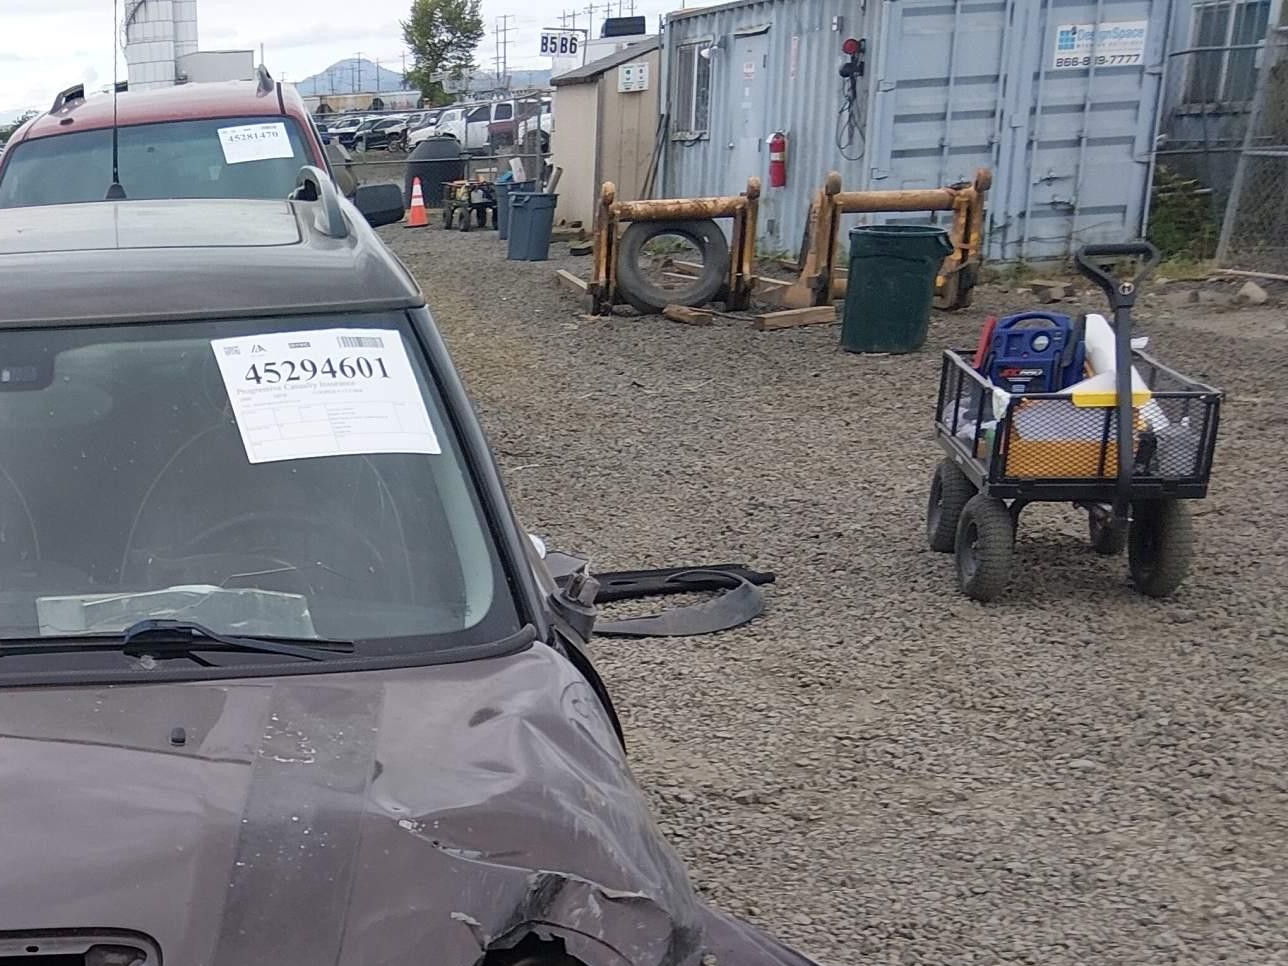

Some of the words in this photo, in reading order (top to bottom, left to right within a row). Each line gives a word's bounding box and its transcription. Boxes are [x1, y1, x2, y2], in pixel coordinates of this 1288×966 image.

[541, 36, 558, 54] B5
[560, 36, 578, 54] B6
[245, 356, 391, 384] 45294601
